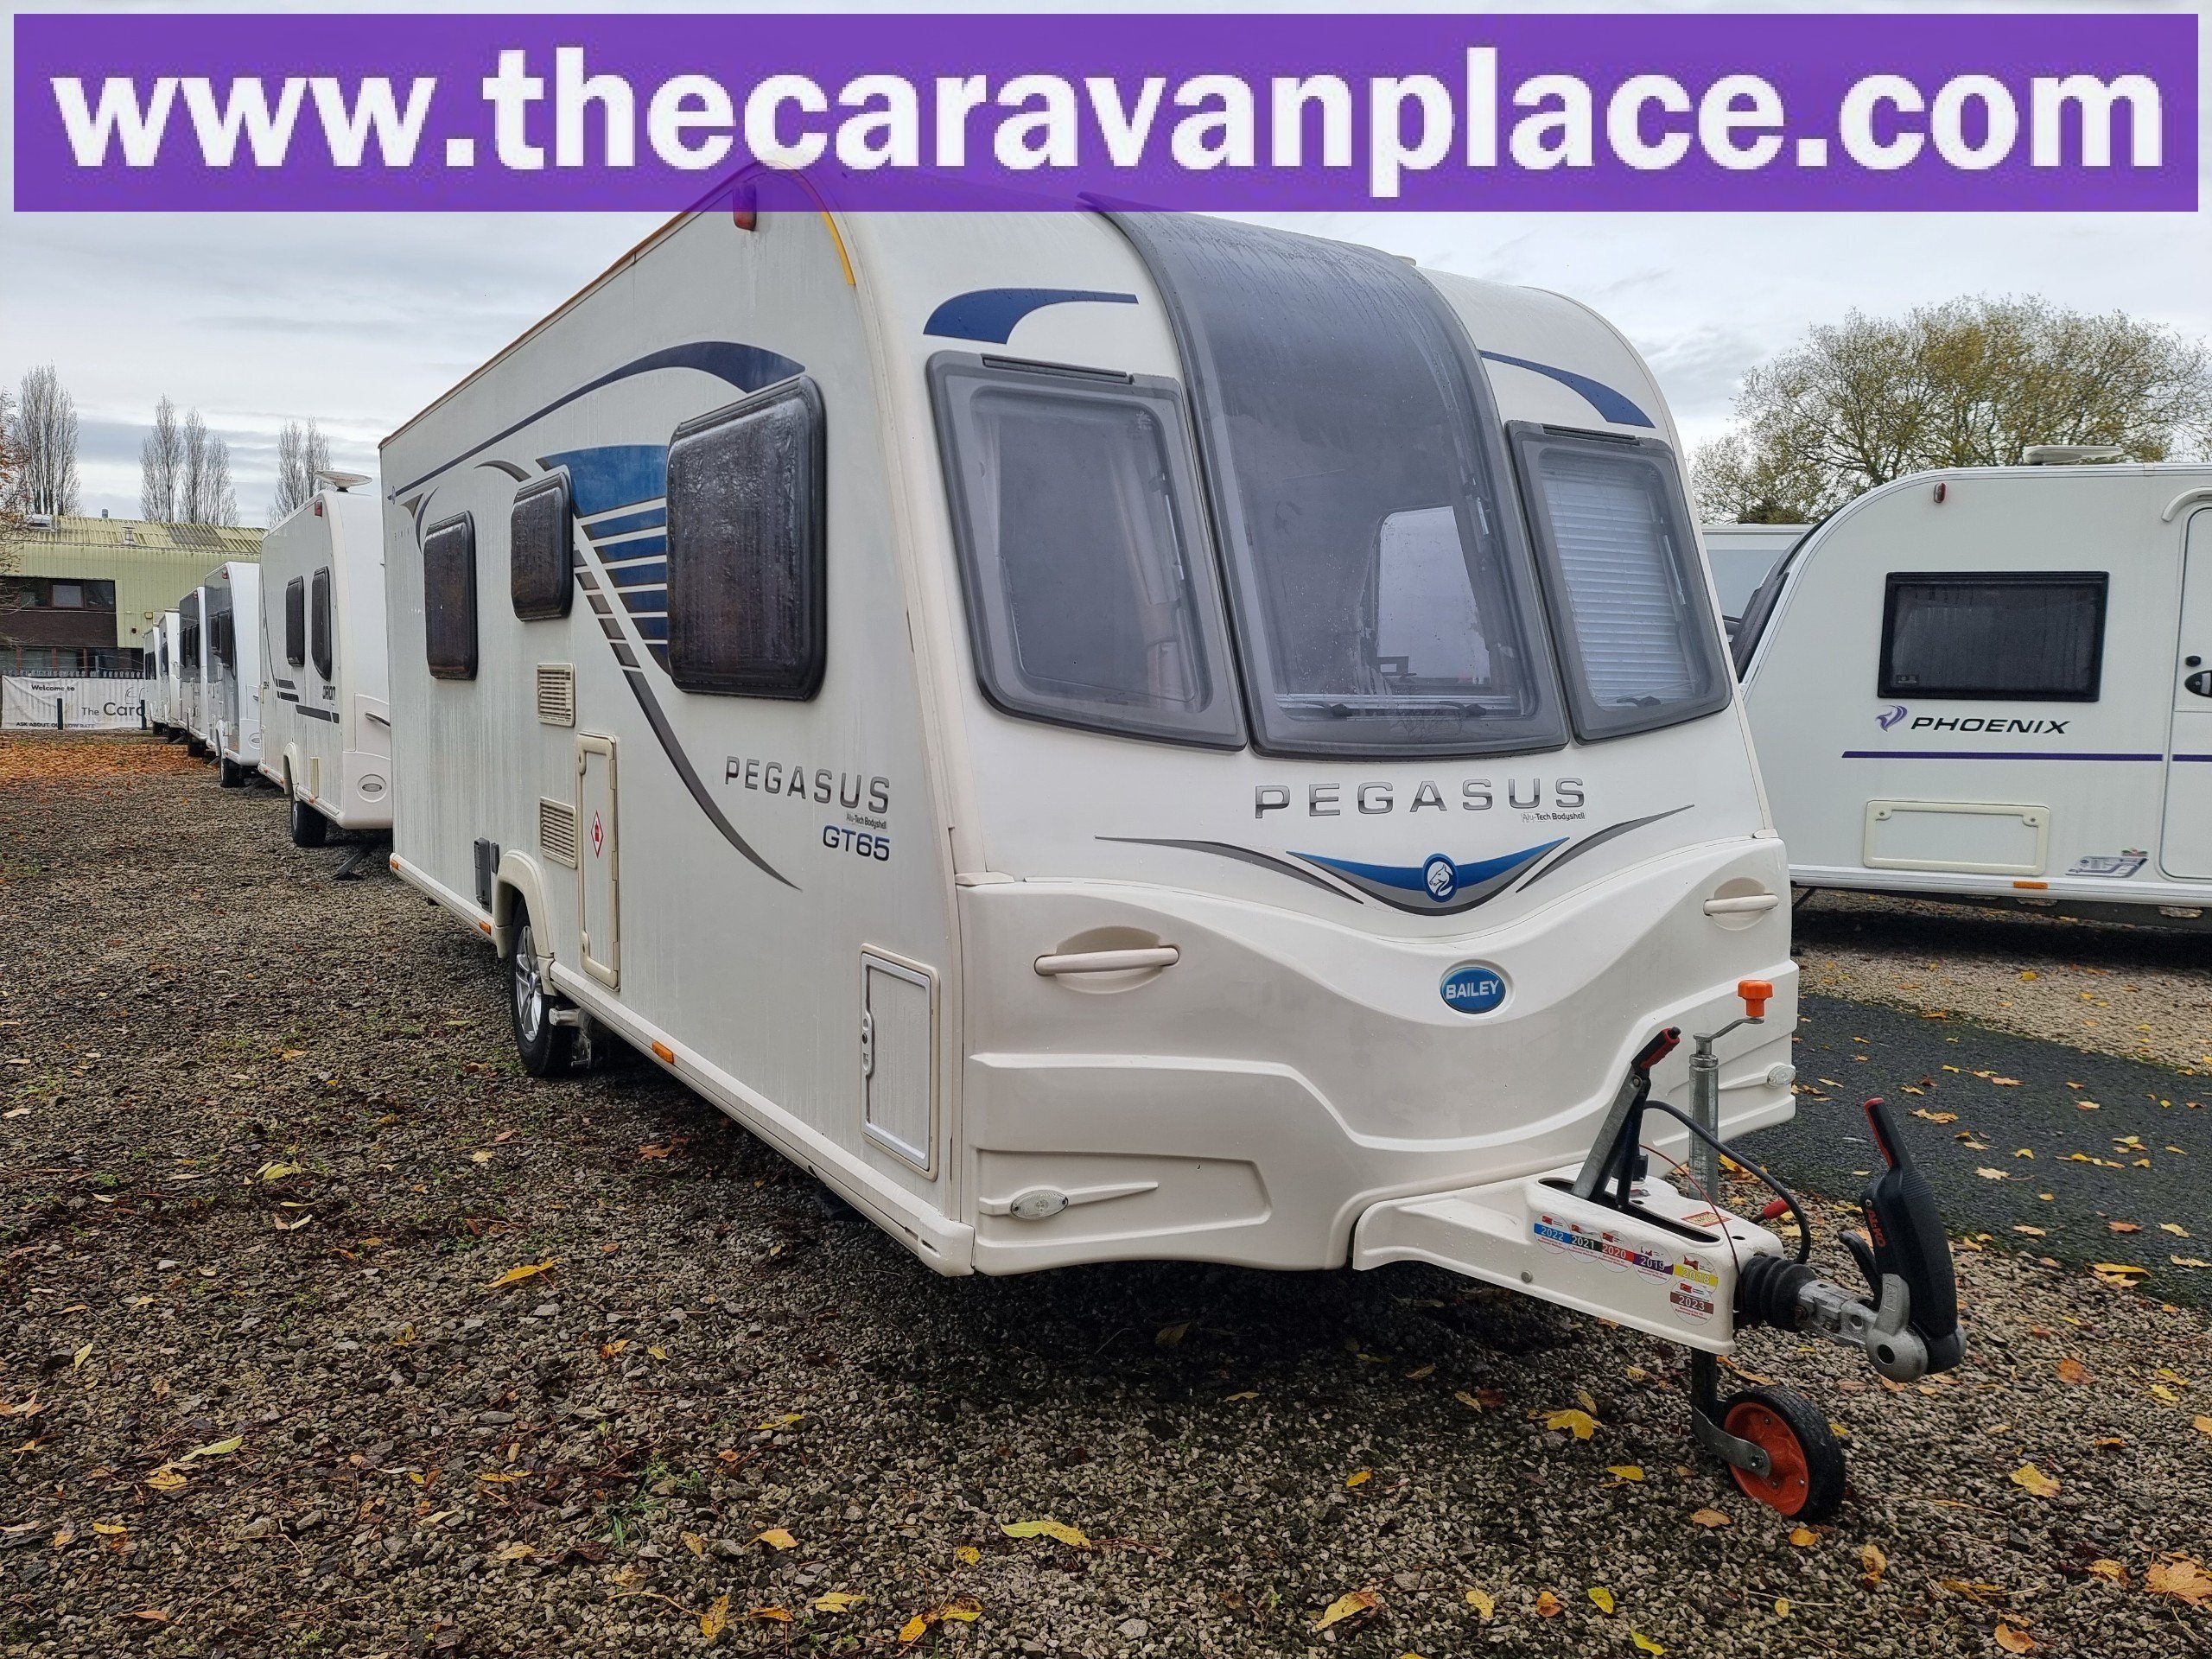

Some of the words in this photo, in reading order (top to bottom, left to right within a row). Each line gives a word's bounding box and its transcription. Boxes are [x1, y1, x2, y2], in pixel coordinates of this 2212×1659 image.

[81, 707, 99, 716] The
[1910, 716, 2071, 735] PHOENIX
[725, 755, 890, 814] PEGASUS
[1255, 777, 1586, 819] PEGASUS
[864, 817, 887, 830] Bodyshell
[1551, 812, 1586, 822] Bodyshell
[823, 824, 890, 861] GT65
[1446, 979, 1500, 1000] BAILEY
[1541, 1226, 1564, 1242] 2022
[1571, 1236, 1595, 1249] 2021
[1602, 1244, 1627, 1259] 2020
[1640, 1256, 1665, 1271] 2019
[1682, 1268, 1710, 1284] 2018
[1678, 1295, 1706, 1311] 2023
